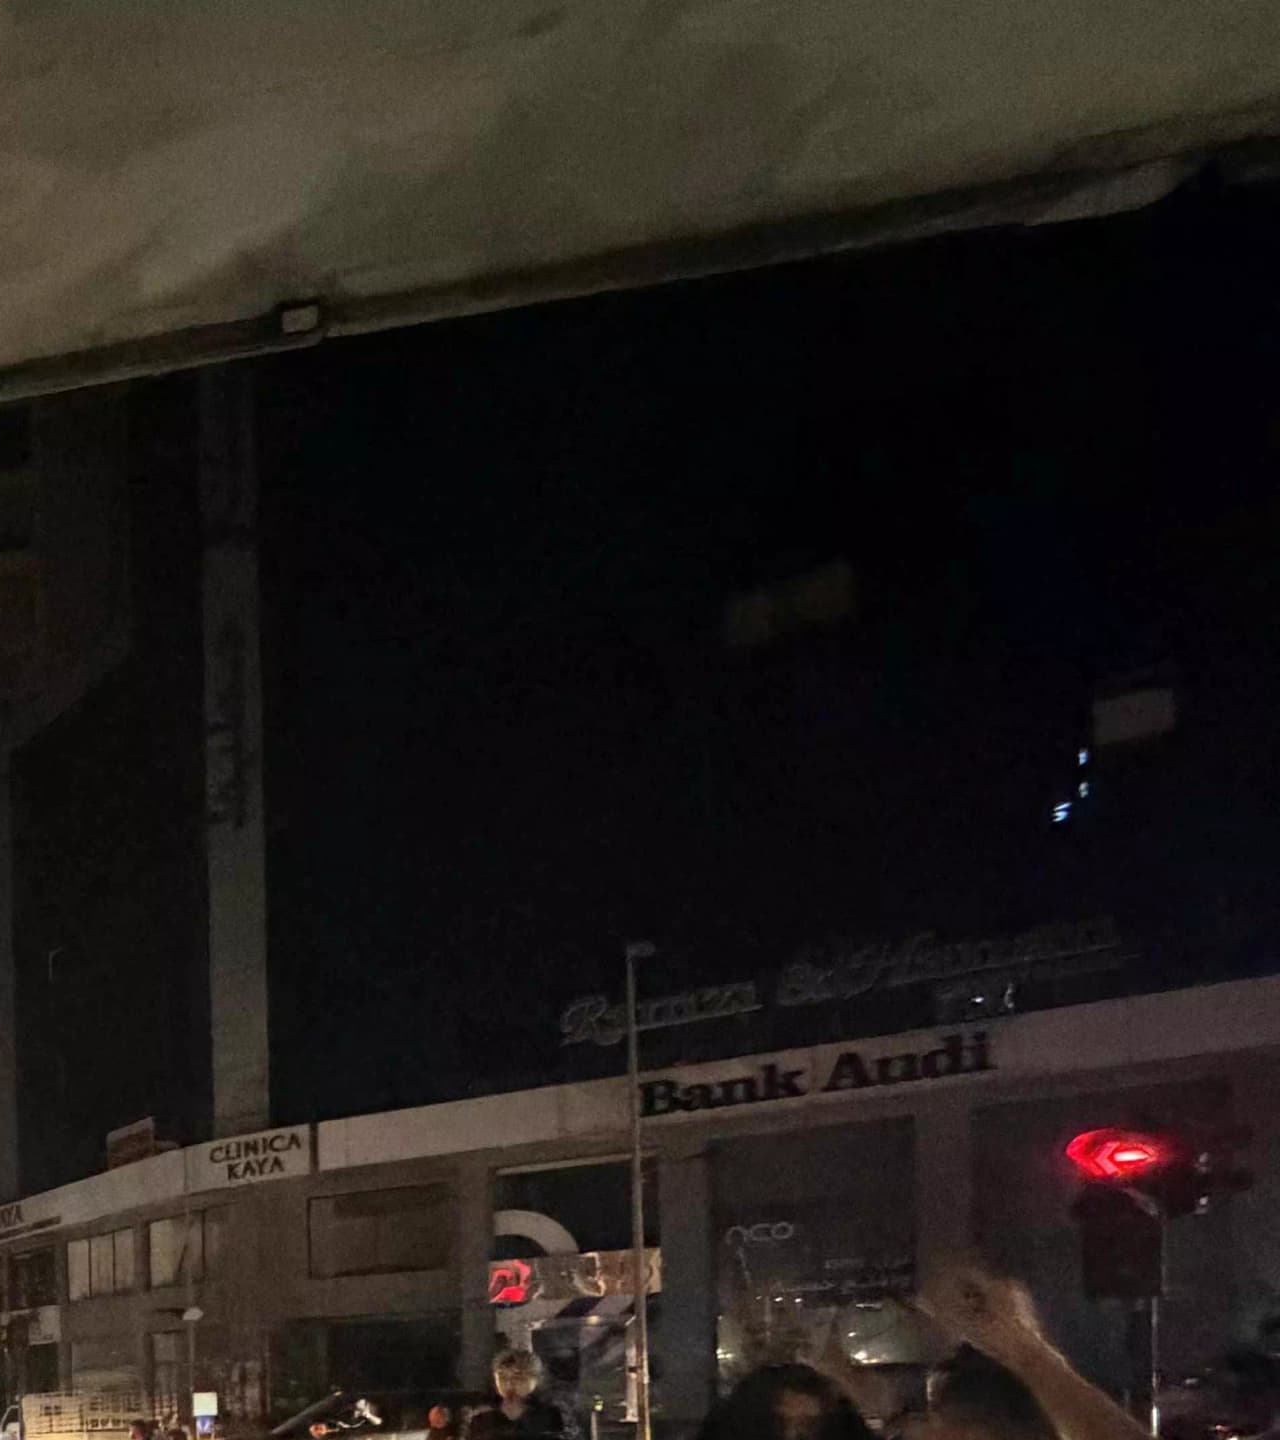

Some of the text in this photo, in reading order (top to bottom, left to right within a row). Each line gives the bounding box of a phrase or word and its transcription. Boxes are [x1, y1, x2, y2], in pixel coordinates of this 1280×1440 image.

[640, 1032, 998, 1117] Bank Audi
[209, 1133, 301, 1163] CLINICA
[227, 1156, 284, 1181] KAYA
